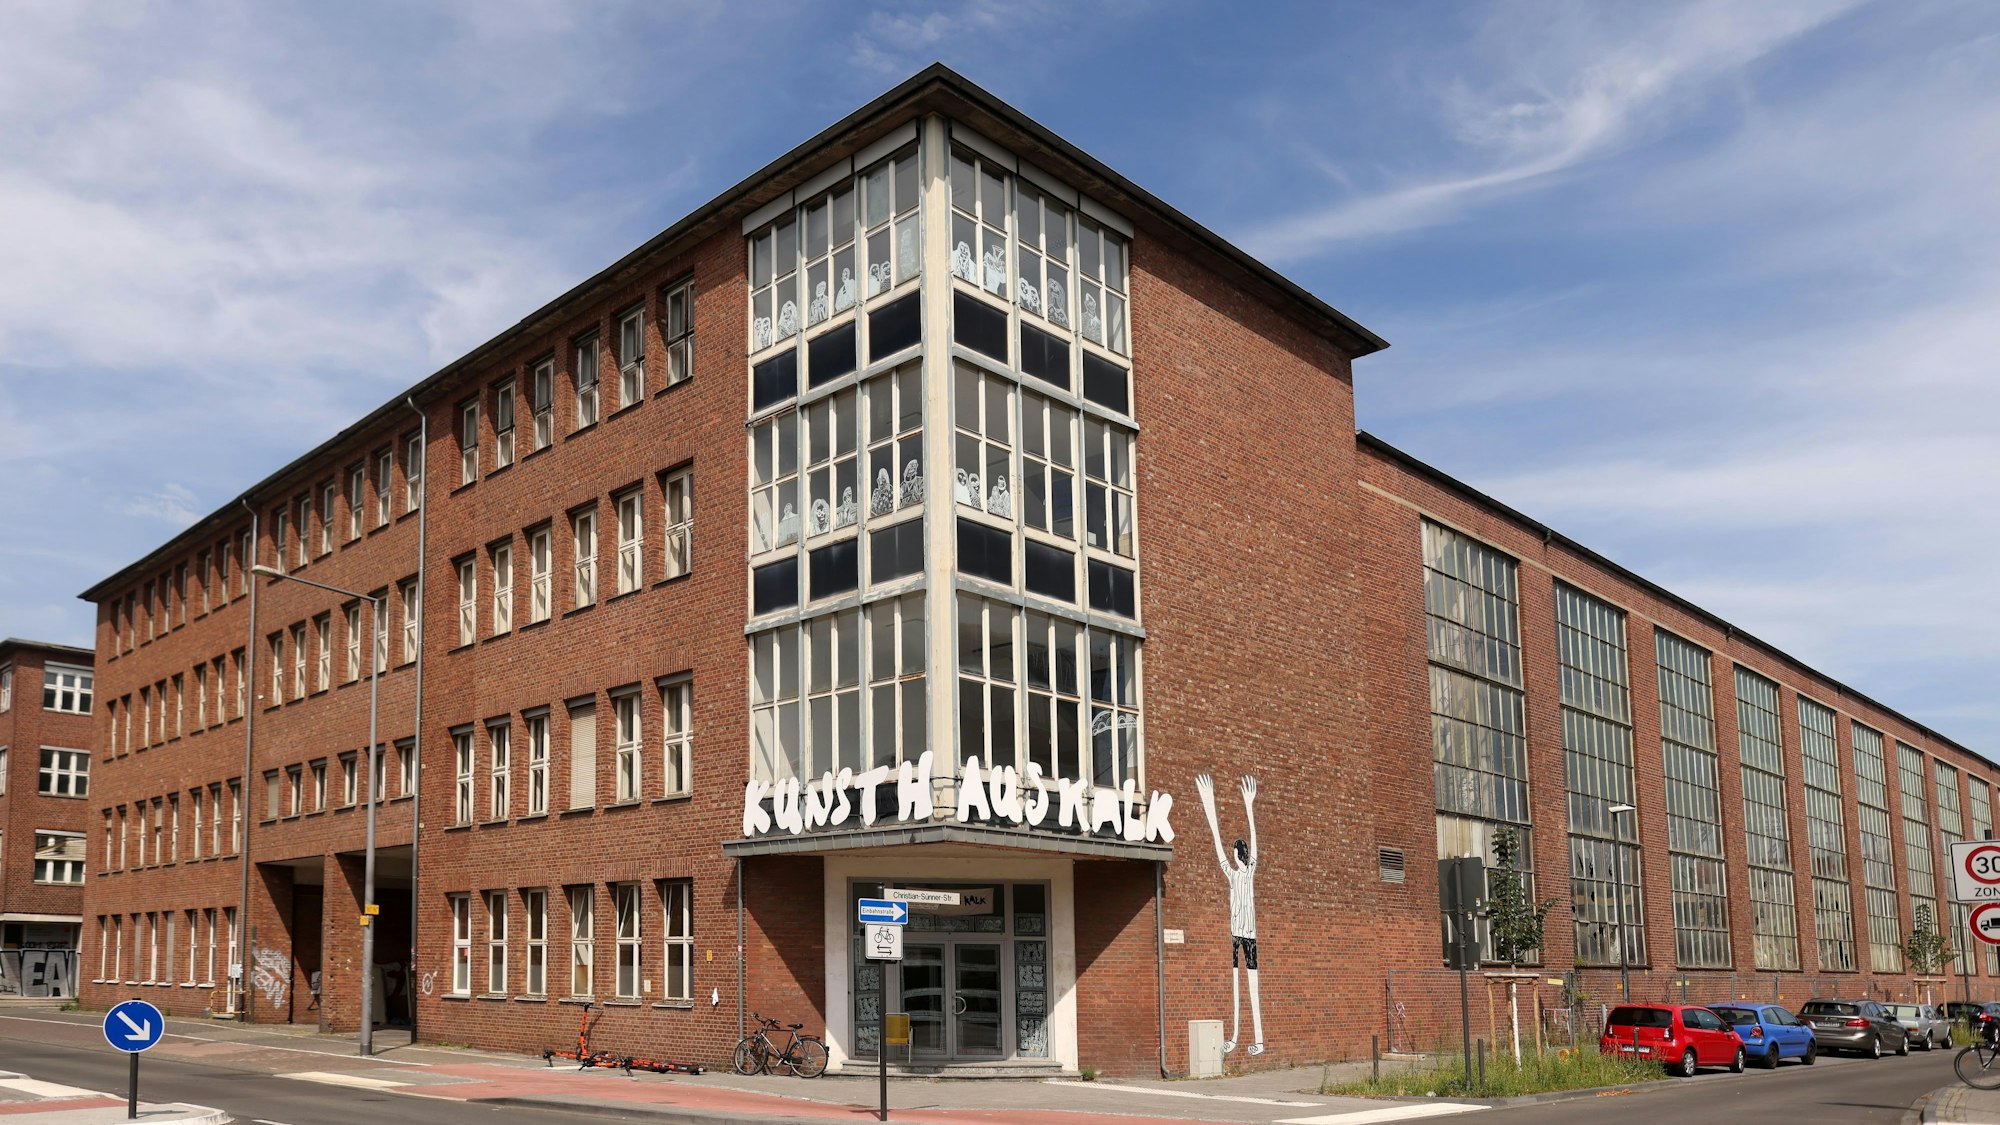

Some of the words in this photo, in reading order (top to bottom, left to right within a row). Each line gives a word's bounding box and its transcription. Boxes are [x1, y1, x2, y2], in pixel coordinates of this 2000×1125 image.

[1976, 856, 2000, 874] 30
[892, 891, 954, 902] Christian-Sünner-Str.
[862, 907, 895, 915] Einbahnstraße
